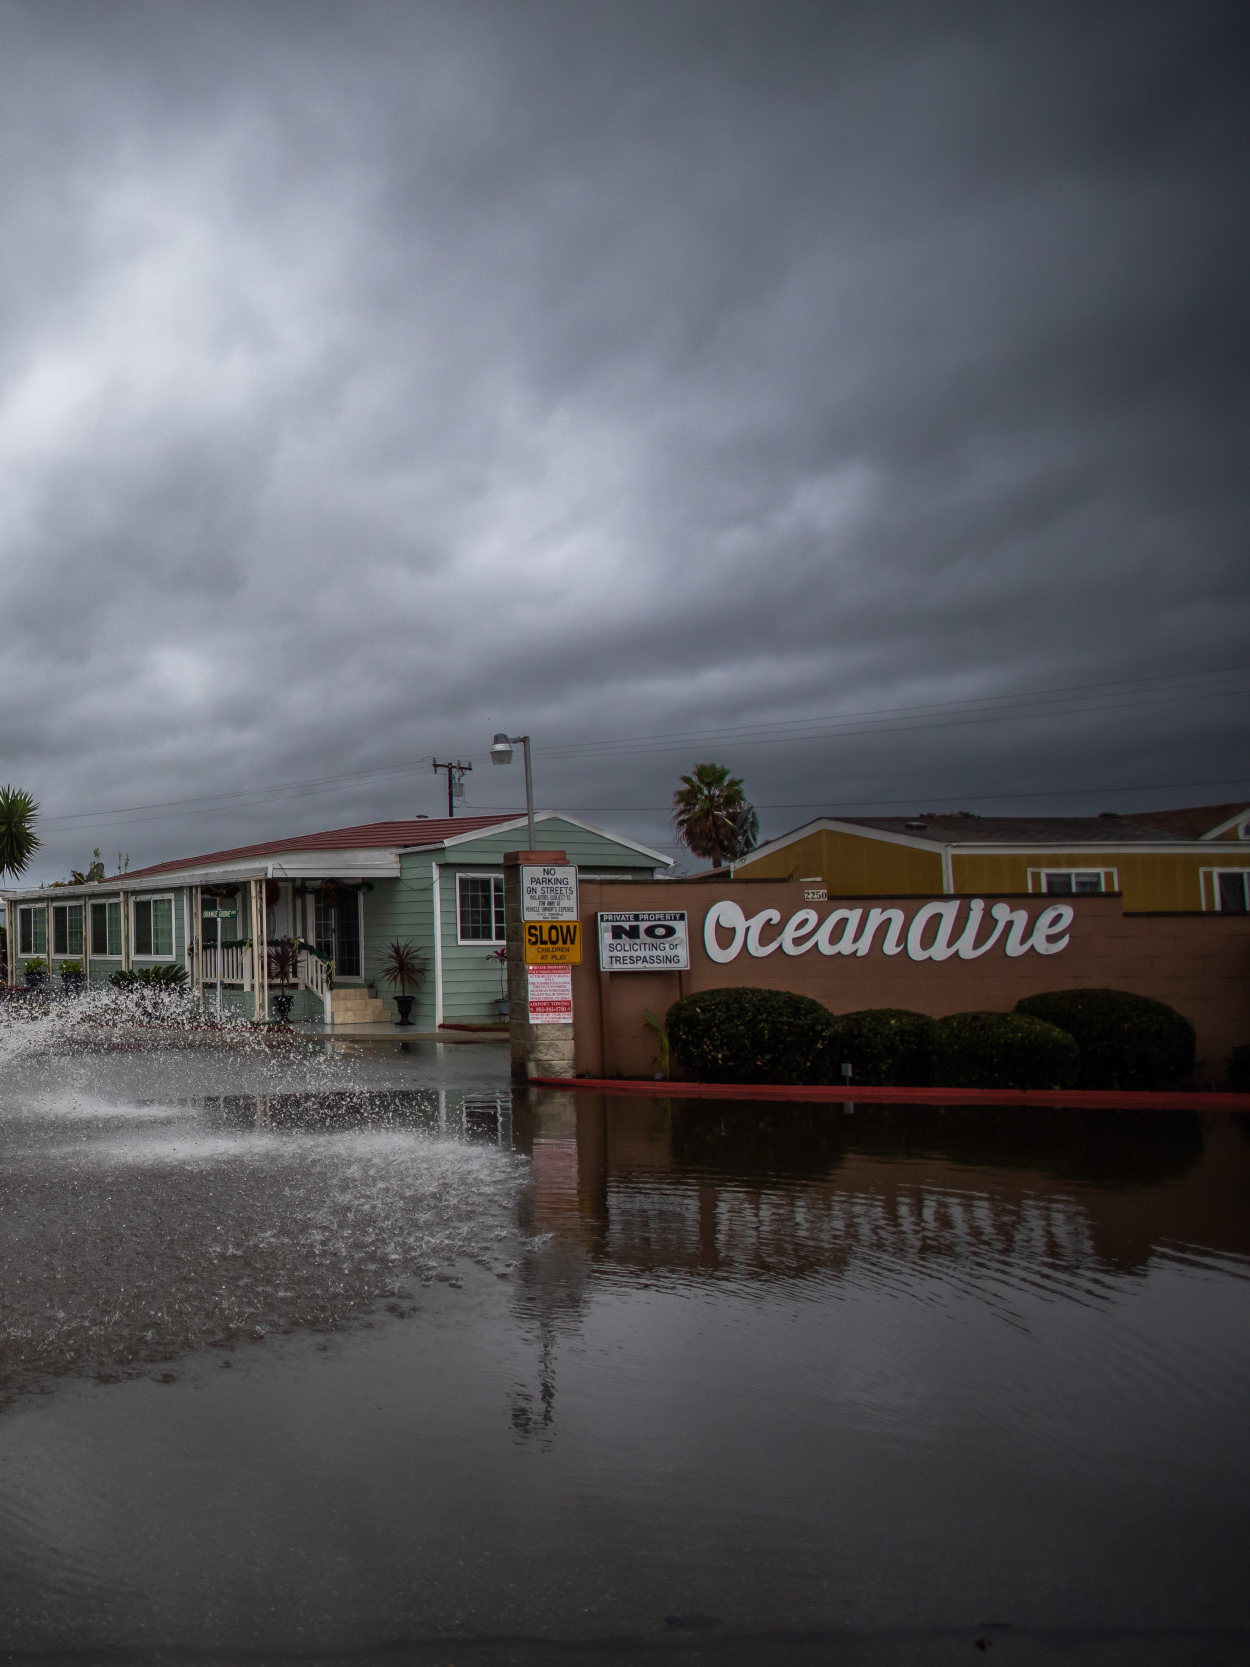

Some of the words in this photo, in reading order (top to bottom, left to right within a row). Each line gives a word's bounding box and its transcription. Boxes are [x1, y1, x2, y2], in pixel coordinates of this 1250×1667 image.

[543, 868, 556, 876] NO
[531, 877, 569, 885] PARKING
[527, 887, 537, 895] ON
[541, 887, 573, 895] STREETS
[805, 891, 827, 900] 2250
[528, 925, 577, 945] SLOW
[611, 924, 676, 939] NO
[704, 899, 1074, 964] Oceanaire
[609, 943, 665, 952] SOLICITING
[609, 955, 680, 965] TRESPASSING
